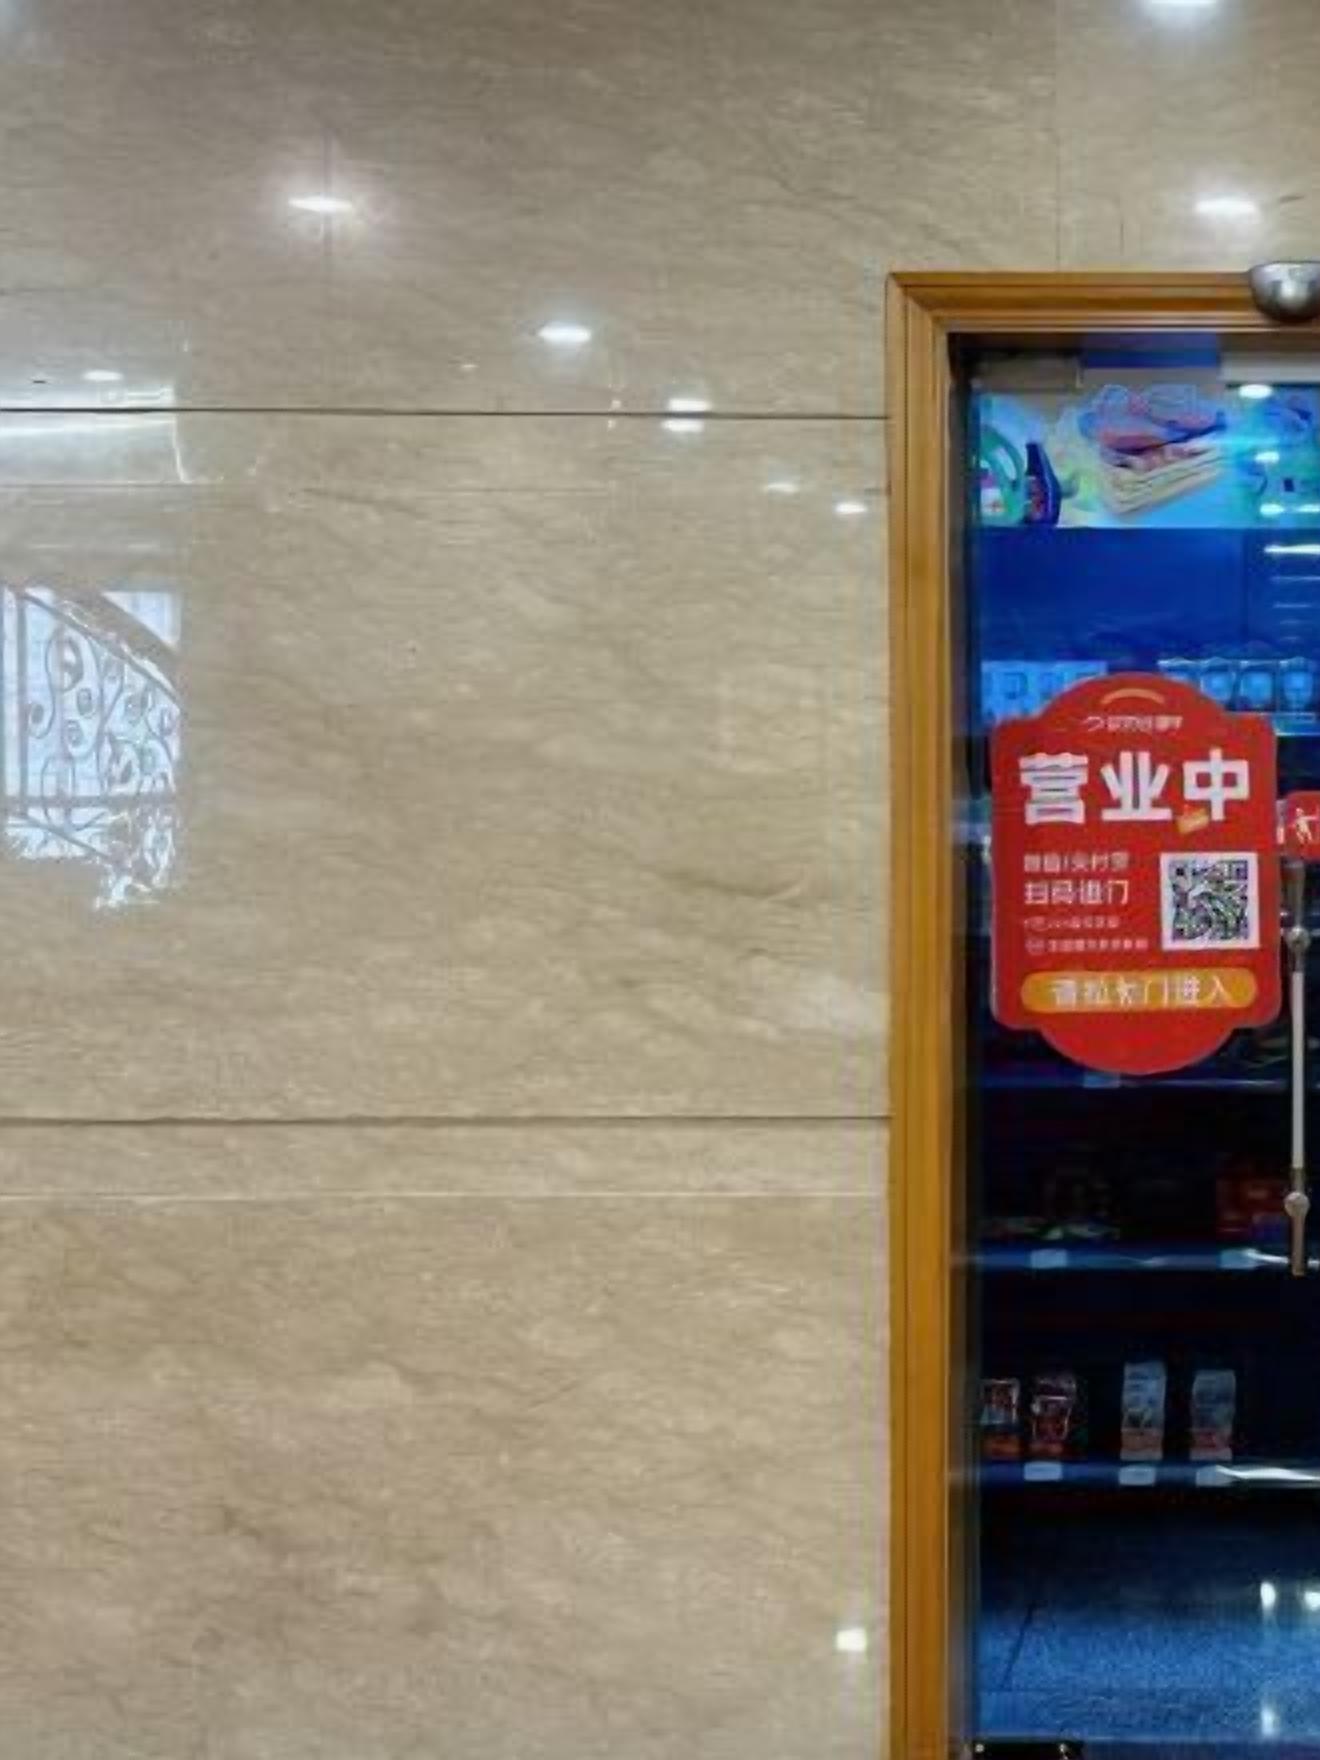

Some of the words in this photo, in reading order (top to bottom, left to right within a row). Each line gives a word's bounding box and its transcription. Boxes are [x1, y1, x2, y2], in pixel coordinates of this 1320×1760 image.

[1018, 748, 1251, 826] 营业中
[1023, 878, 1131, 907] 扫码进门
